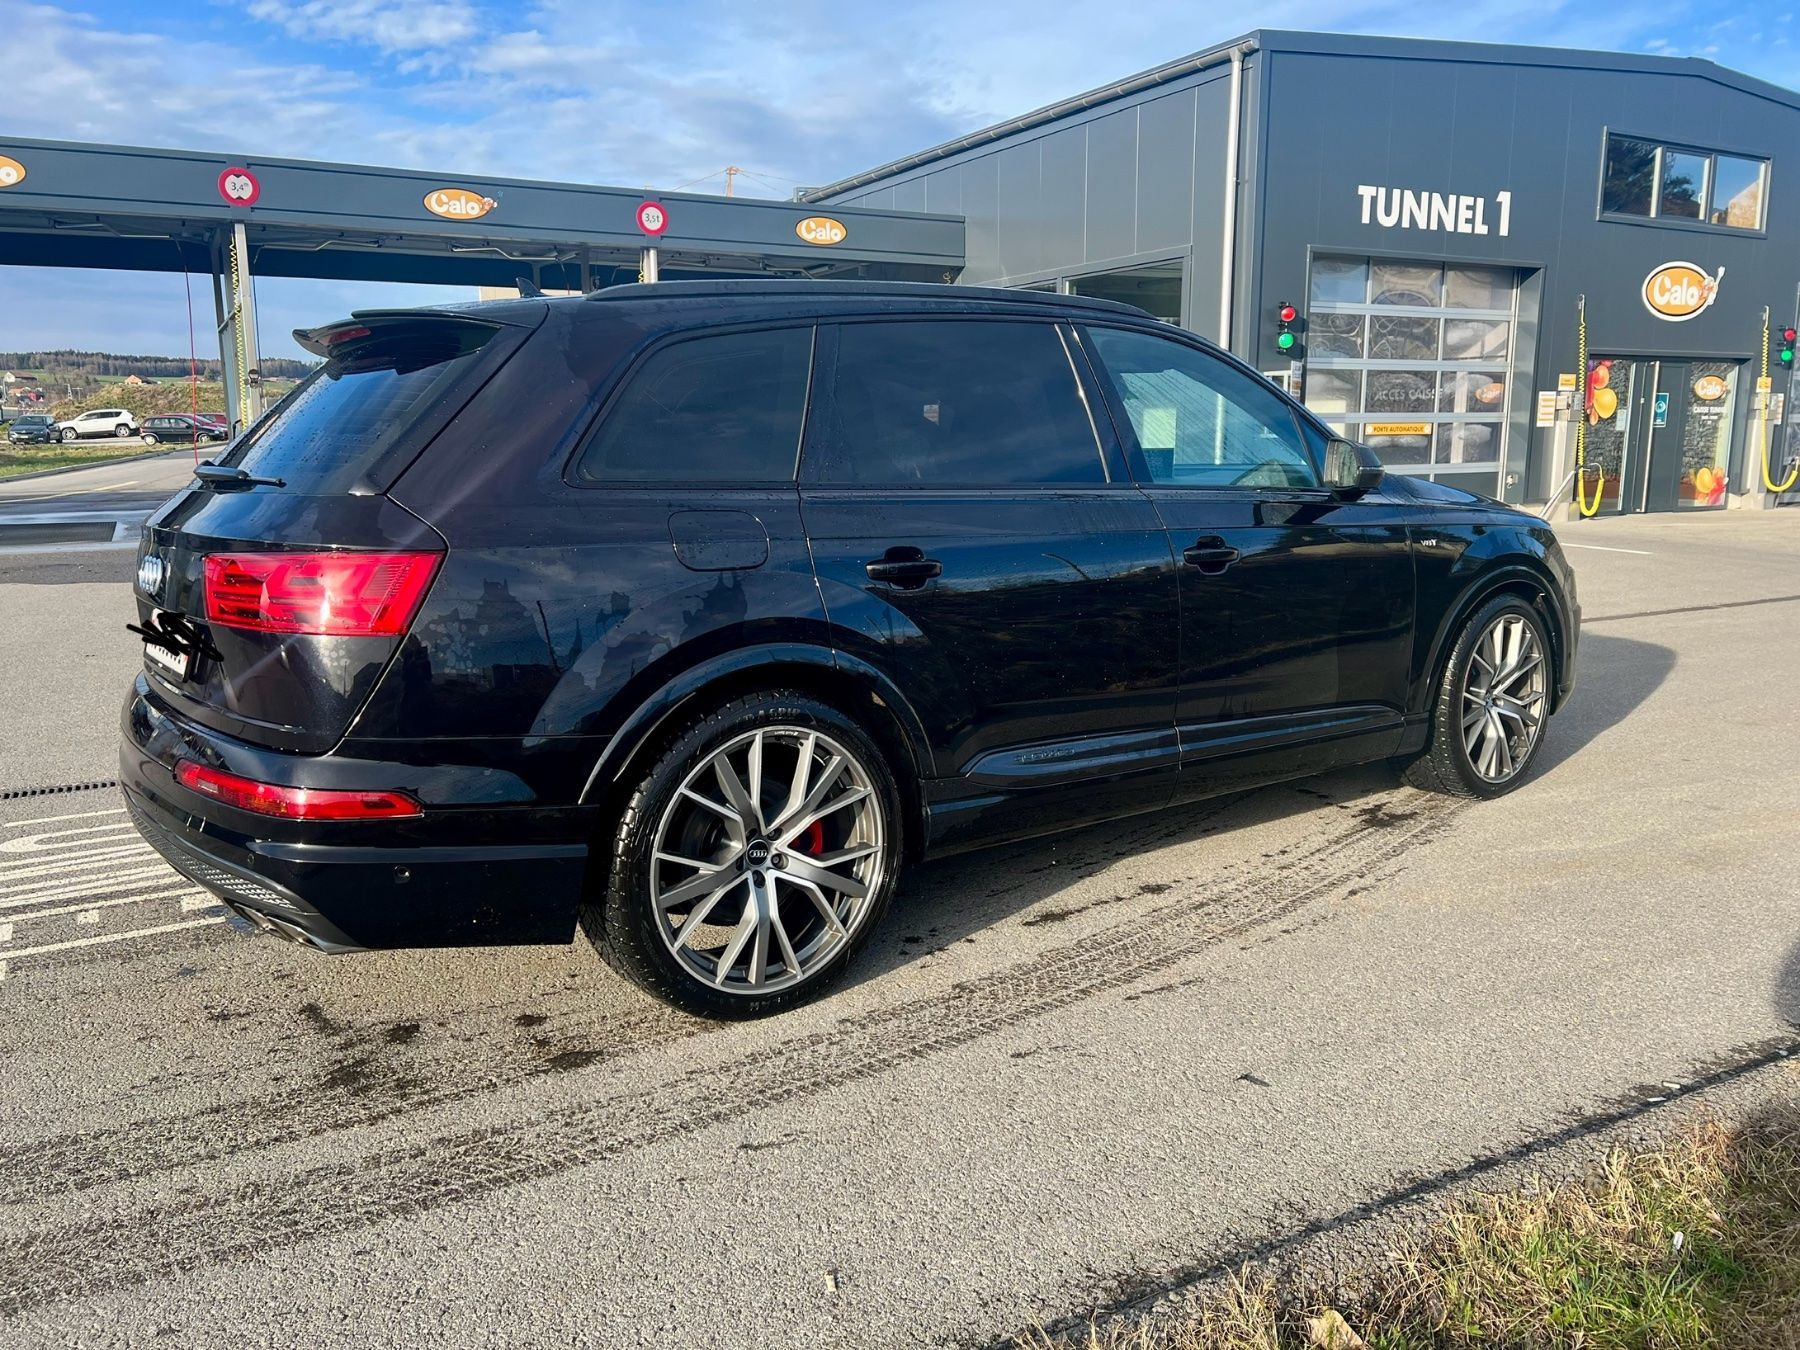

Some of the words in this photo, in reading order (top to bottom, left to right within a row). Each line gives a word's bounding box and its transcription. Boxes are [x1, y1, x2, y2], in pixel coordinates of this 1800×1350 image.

[431, 192, 480, 215] Calo
[1358, 185, 1488, 235] TUNNEL
[1496, 191, 1511, 236] 1
[801, 220, 841, 241] Calo
[1653, 275, 1699, 306] Calo
[1700, 380, 1721, 394] Calo
